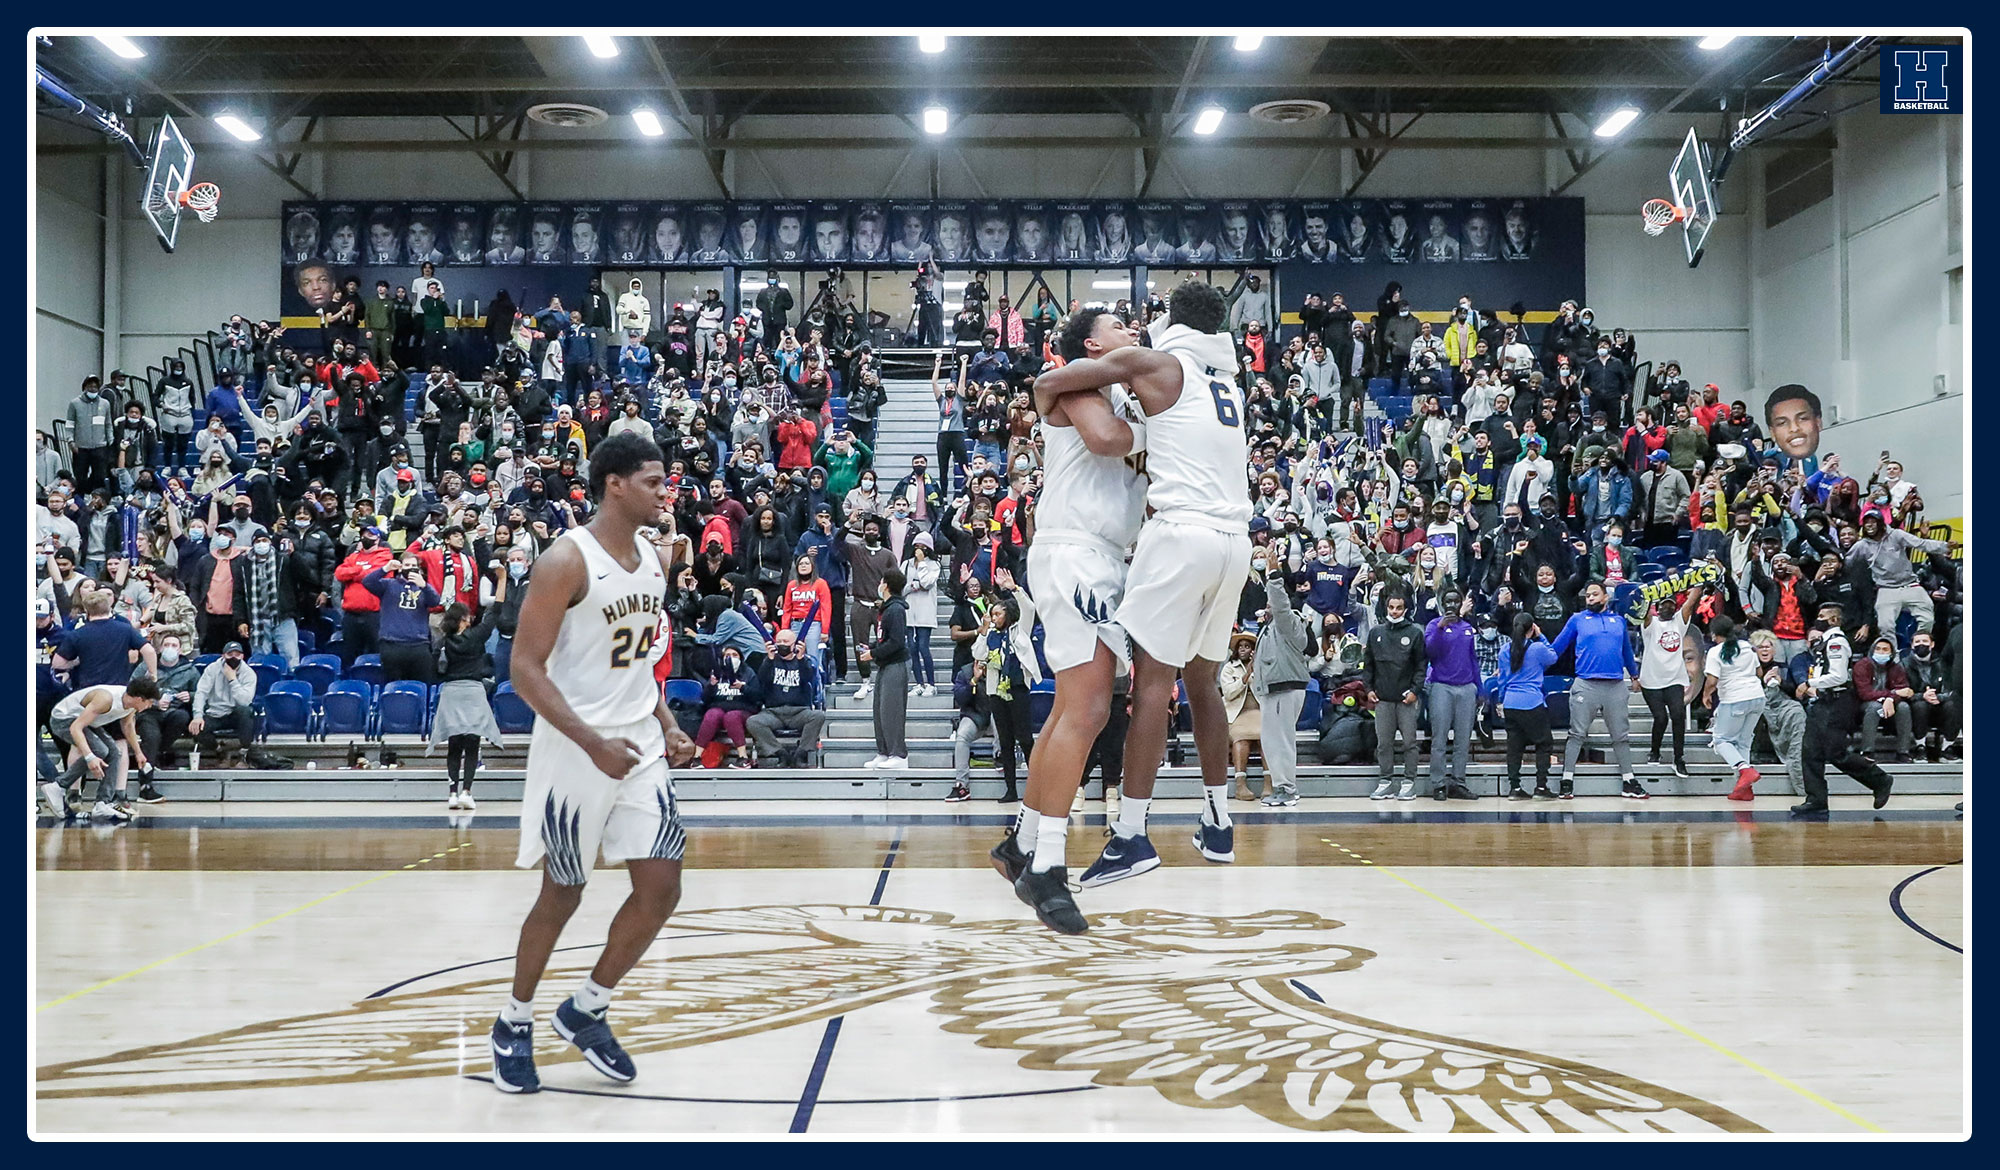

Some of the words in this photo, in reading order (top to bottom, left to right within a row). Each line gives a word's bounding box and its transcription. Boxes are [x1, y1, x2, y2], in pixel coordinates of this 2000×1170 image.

[704, 251, 715, 260] 22
[744, 251, 753, 260] 21
[784, 250, 796, 259] 29
[867, 250, 873, 259] 9
[908, 251, 914, 259] 2
[948, 250, 955, 259] 5
[990, 250, 995, 259] 3
[1030, 250, 1036, 259] 3
[1070, 250, 1079, 259] 11
[1190, 249, 1201, 257] 23
[1272, 248, 1282, 257] 10
[1433, 246, 1445, 256] 24
[297, 252, 307, 261] 10
[337, 252, 347, 261] 12
[378, 252, 388, 261] 19
[418, 253, 429, 262] 24
[543, 252, 549, 260] 6
[584, 252, 589, 261] 3
[622, 252, 633, 261] 43
[664, 252, 673, 261] 18
[1209, 380, 1240, 428] 6
[1317, 572, 1343, 581] IMPACT
[1641, 564, 1717, 602] HAWKS
[792, 591, 816, 600] CAN
[602, 593, 661, 625] HUMBE
[610, 626, 655, 669] 24
[774, 667, 786, 678] WE
[787, 670, 800, 679] ARE
[773, 675, 800, 687] FAMILY
[716, 688, 743, 696] FAMIL
